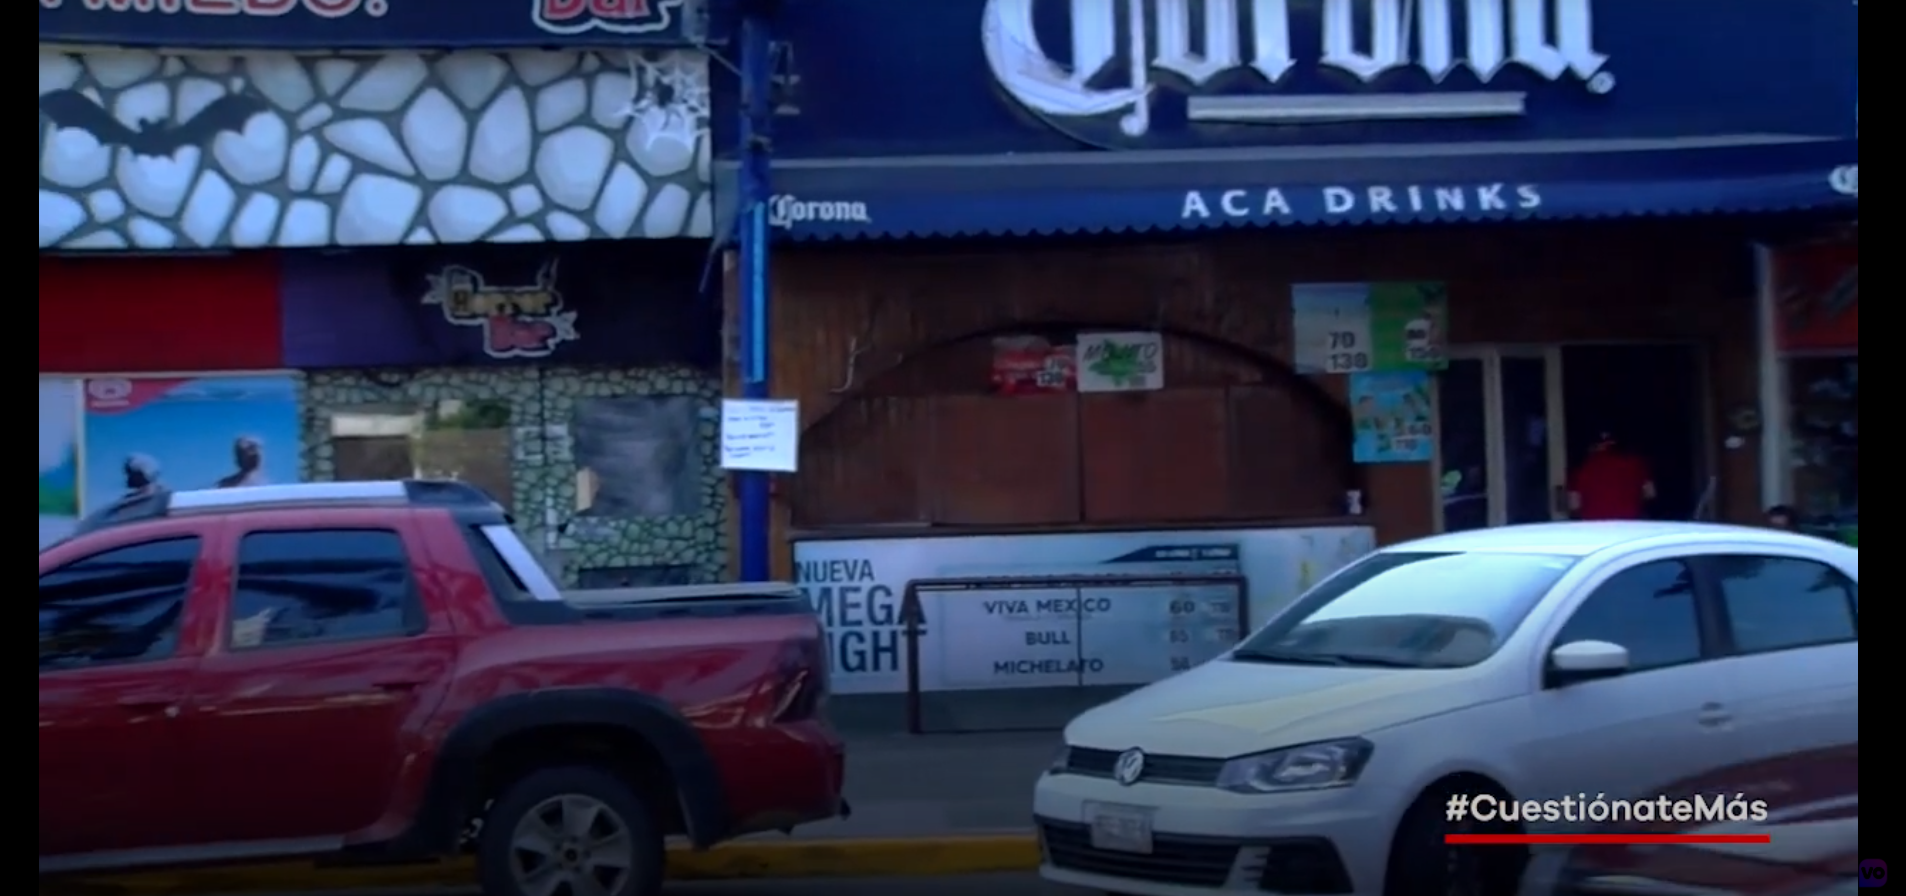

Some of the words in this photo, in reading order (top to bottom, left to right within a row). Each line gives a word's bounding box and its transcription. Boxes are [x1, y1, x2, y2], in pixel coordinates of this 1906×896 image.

[768, 194, 868, 230] Corona
[1181, 187, 1293, 218] ACA
[1322, 182, 1542, 213] DRINKS
[796, 559, 875, 583] NUEVA
[799, 585, 928, 628] MEGA
[984, 600, 1029, 615] VIVA
[1036, 598, 1111, 613] MEXCO
[1026, 631, 1070, 645] BULL
[994, 658, 1104, 675] MICHELATO
